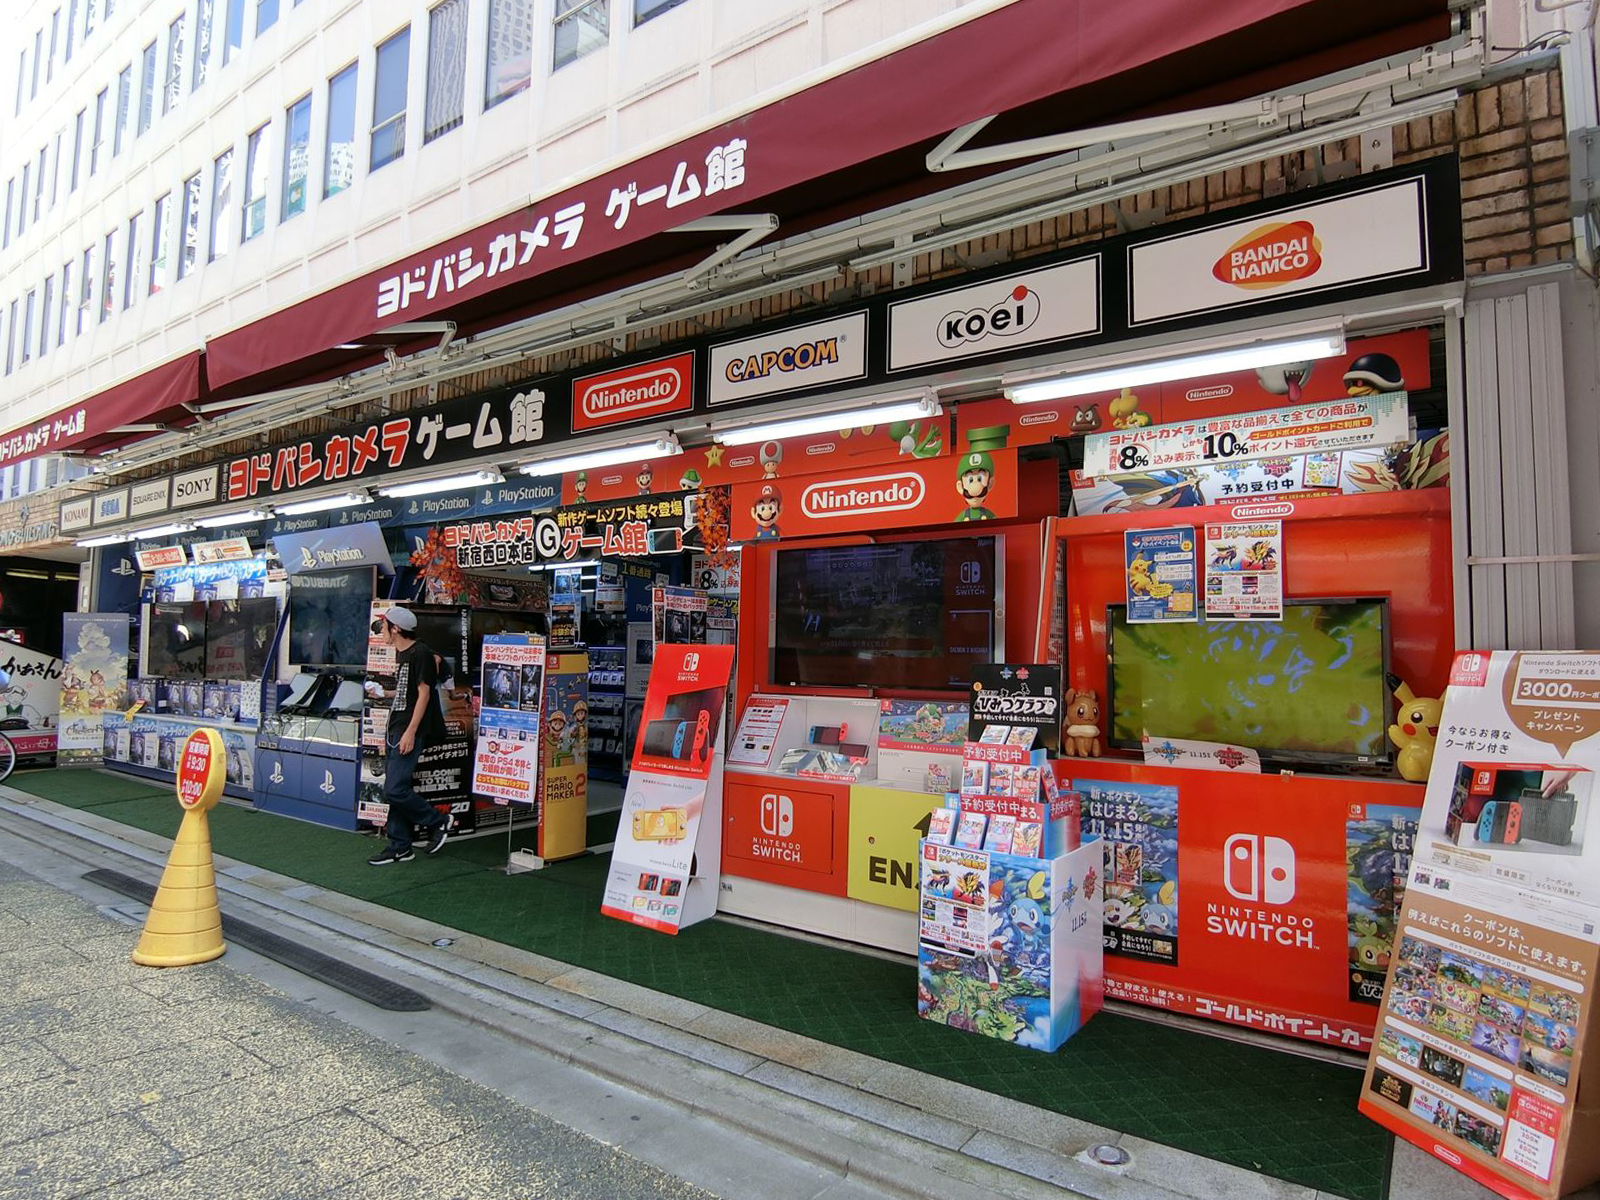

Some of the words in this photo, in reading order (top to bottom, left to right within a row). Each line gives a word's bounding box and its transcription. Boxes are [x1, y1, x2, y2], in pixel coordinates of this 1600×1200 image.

[377, 202, 586, 318] ヨドバシカメラ
[605, 138, 747, 230] ゲーム館
[1230, 236, 1308, 267] BANDAI
[1230, 253, 1309, 283] NAMCO
[724, 337, 838, 383] CAPCOM
[590, 377, 673, 411] Nintendo
[1190, 387, 1231, 399] Nintendo
[416, 388, 545, 460] ゲーム館
[1020, 413, 1056, 425] Nintendo
[228, 418, 411, 500] ヨドバシカメラ
[1119, 445, 1149, 469] 8%
[1182, 438, 1203, 449] しかも
[1203, 431, 1248, 460] 10%
[176, 477, 213, 498] SONY
[498, 486, 556, 504] PlayStation
[811, 481, 914, 510] Nintendo
[1221, 478, 1294, 495] 予約受付中
[101, 498, 119, 517] SEGA
[423, 496, 471, 513] PlayStation
[1237, 506, 1290, 517] Nintendo
[63, 507, 89, 523] KONAMI
[352, 508, 393, 522] PlayStation
[558, 500, 684, 528] 新作ゲームソフト続々登場
[284, 518, 318, 531] PlayStation
[444, 517, 534, 547] ヨドバシカメラ
[562, 523, 648, 559] ゲーム館
[318, 547, 365, 563] PlayStation
[457, 541, 534, 568] 新宿西口本店
[1533, 710, 1580, 722] プレゼント
[1448, 725, 1512, 740] 今ならお得な
[1526, 721, 1584, 733] キャンペーン
[963, 746, 1022, 762] 予約受付中
[1445, 739, 1509, 755] クーポン付き
[191, 758, 206, 772] 9:30
[412, 768, 462, 780] WELCOME
[420, 777, 433, 785] TO
[434, 776, 455, 784] THE
[546, 781, 573, 791] MARIO
[574, 773, 586, 798] 2
[547, 775, 567, 784] SUPER
[546, 790, 575, 801] MAKER
[961, 798, 1020, 815] 予約受付中
[1089, 801, 1145, 823] はじまる。
[752, 844, 801, 862] SWITCH
[753, 837, 801, 851] NINTENDO
[672, 859, 688, 871] Lite
[869, 855, 919, 891] EN
[1207, 903, 1314, 928] NINTENDO
[1206, 915, 1314, 949] SWITCH
[1463, 912, 1525, 940] クーポンは、
[1407, 908, 1587, 976] 例えばこれらのソフトに使えます。
